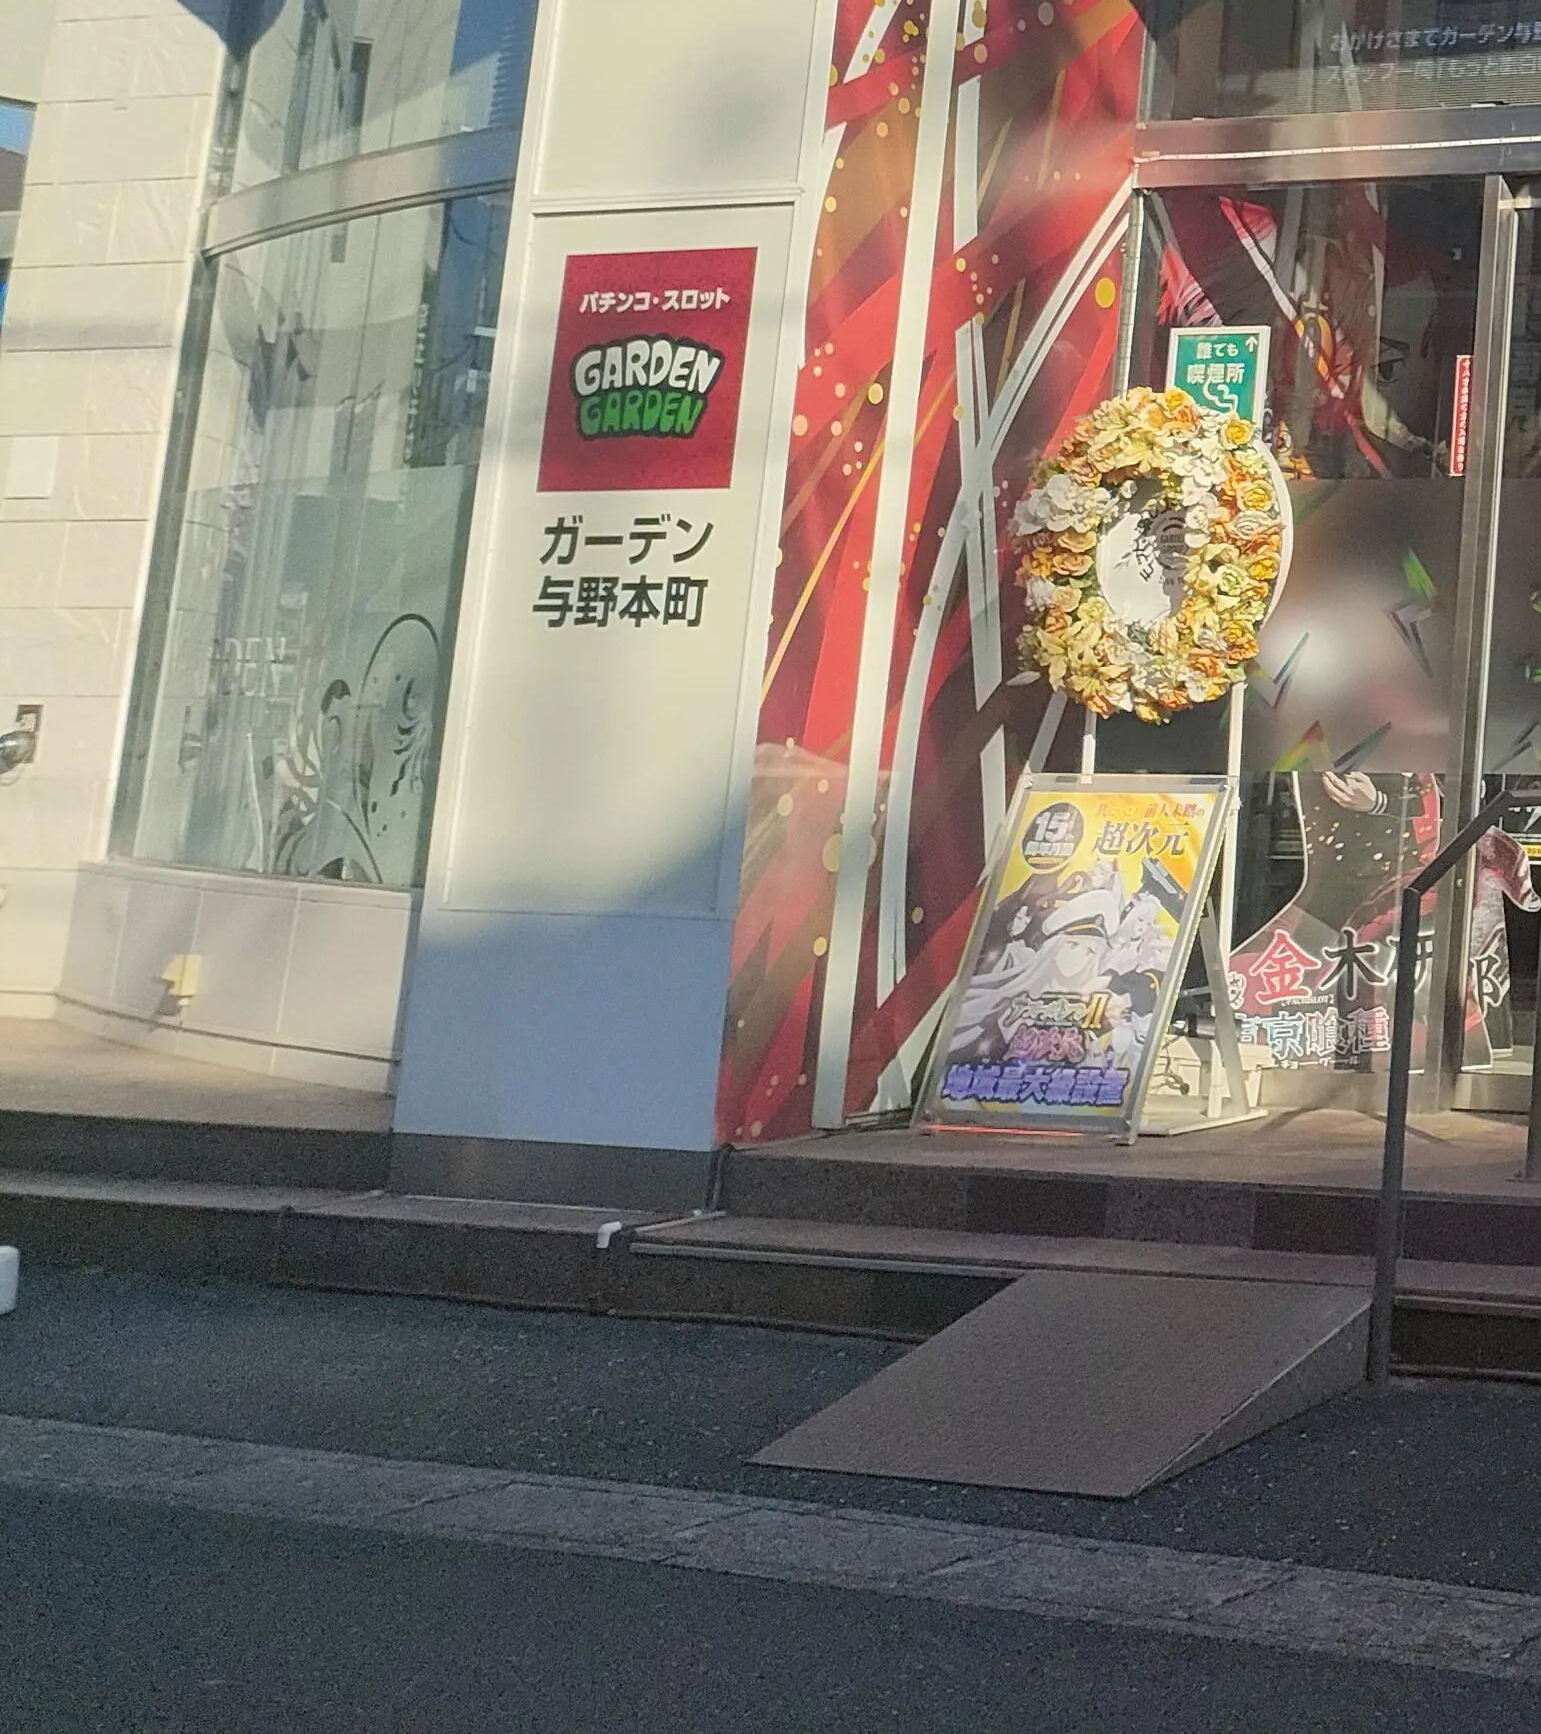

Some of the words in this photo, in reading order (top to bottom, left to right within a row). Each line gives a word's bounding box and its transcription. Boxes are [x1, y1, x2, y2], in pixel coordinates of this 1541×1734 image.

[579, 286, 731, 314] パチンコ・スロット
[574, 339, 723, 398] GARDEN
[1186, 363, 1246, 384] 喫煙所
[579, 390, 704, 436] GARDEN
[539, 514, 714, 565] ガーデン
[532, 575, 709, 628] 与野本町
[1091, 819, 1190, 856] 超次元
